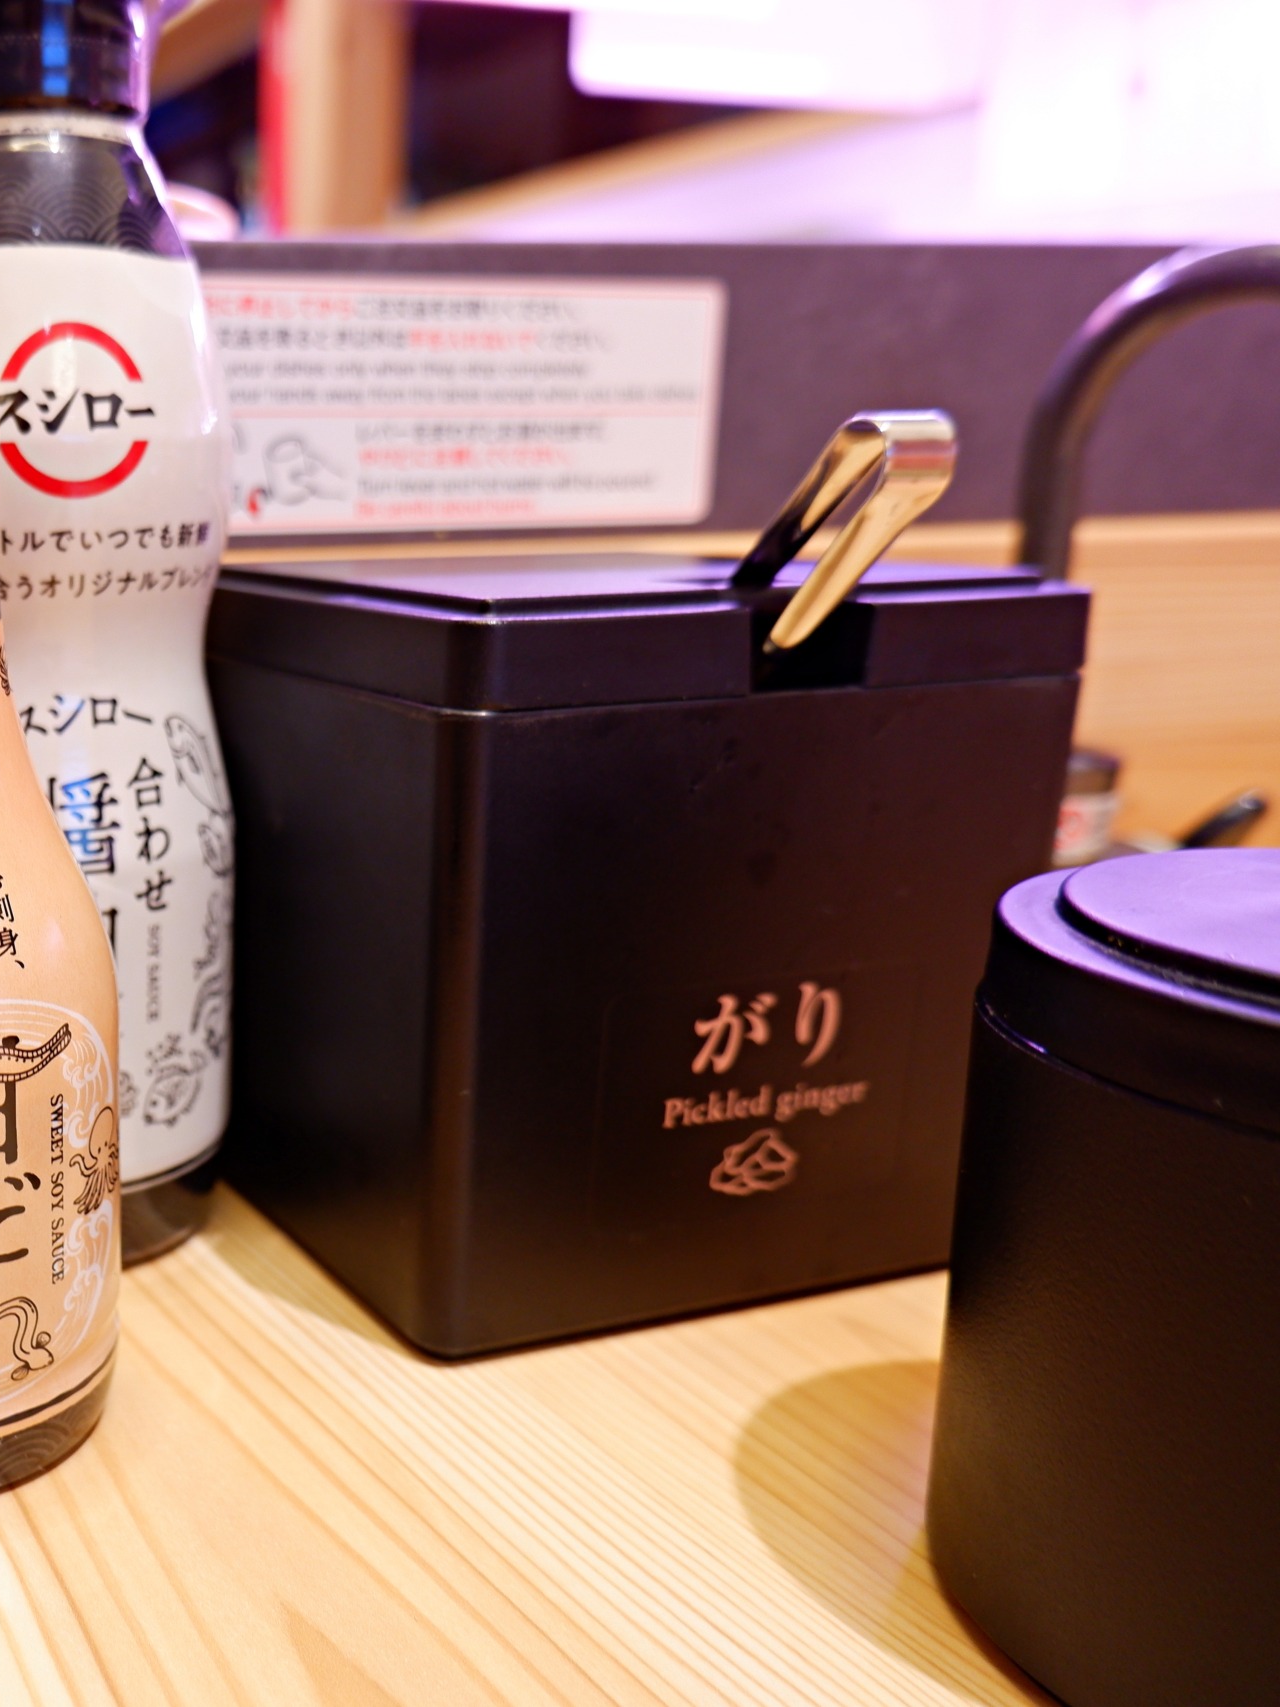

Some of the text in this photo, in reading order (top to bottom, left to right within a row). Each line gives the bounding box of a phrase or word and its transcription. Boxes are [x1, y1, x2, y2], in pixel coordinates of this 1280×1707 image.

[20, 694, 154, 737] スシロー
[127, 757, 174, 913] 合わせ
[691, 981, 842, 1075] がり
[662, 1080, 870, 1129] Pickled ginger
[50, 1093, 65, 1285] SWEET SOY SAUCE
